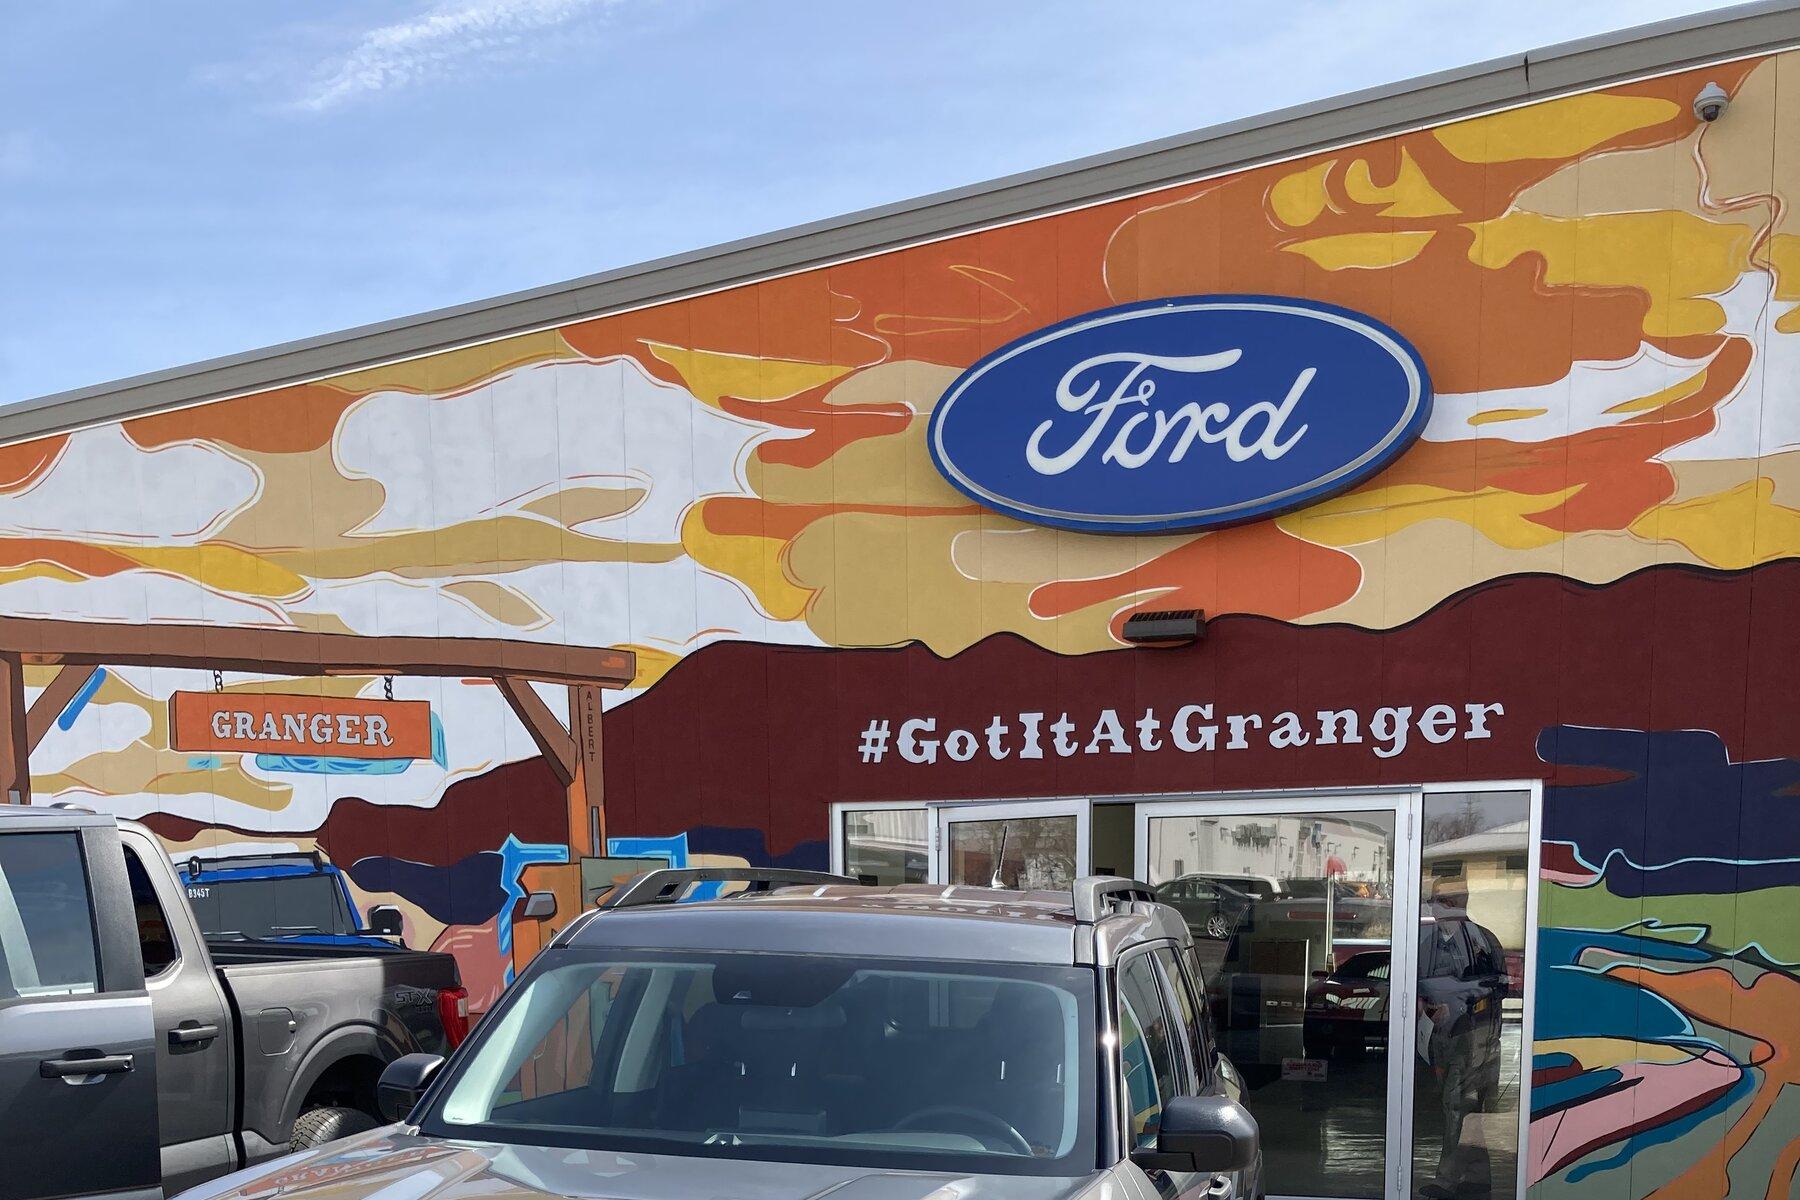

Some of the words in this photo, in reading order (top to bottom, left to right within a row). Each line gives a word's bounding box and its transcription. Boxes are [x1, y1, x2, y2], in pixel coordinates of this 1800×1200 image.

[1026, 348, 1317, 475] Ford
[211, 711, 394, 747] GRANGER
[586, 691, 595, 762] ALBERT
[858, 702, 1504, 765] #GotItAtGranger
